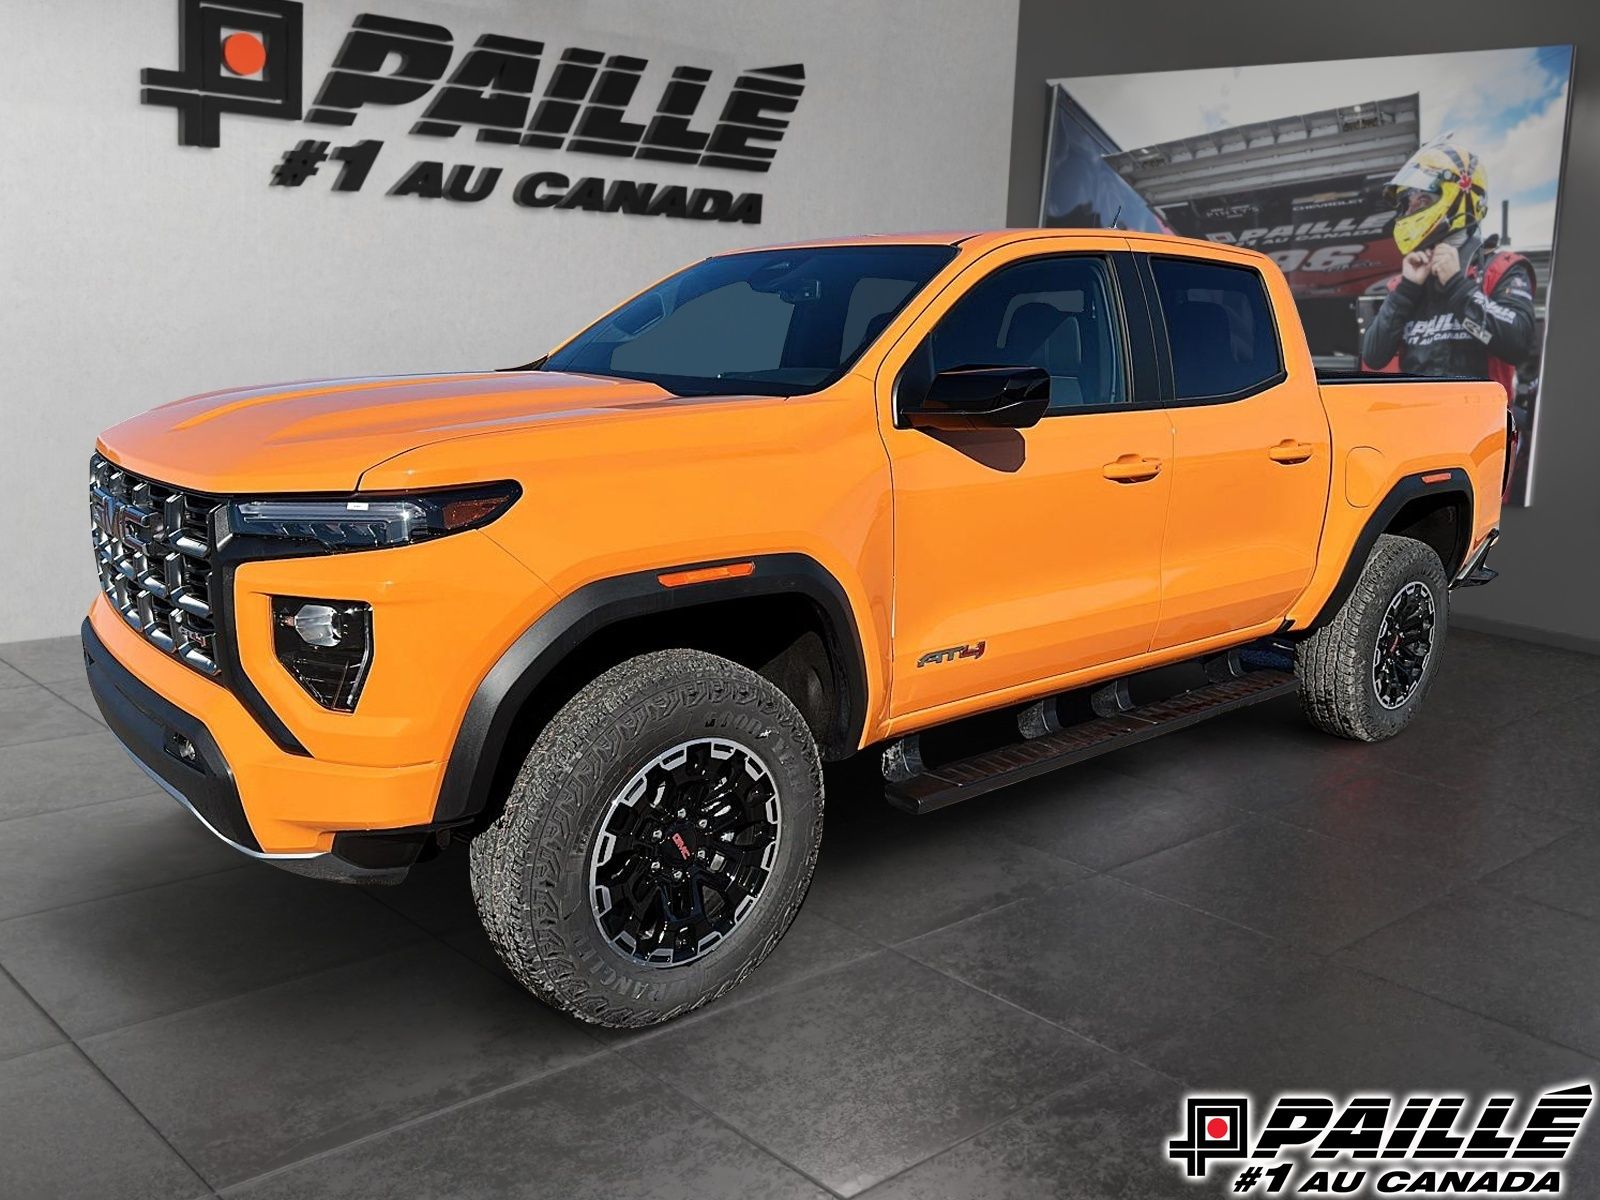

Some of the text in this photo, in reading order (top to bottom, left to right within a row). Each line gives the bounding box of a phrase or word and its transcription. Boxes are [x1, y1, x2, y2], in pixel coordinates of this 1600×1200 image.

[304, 13, 806, 172] PAILLÉ
[269, 139, 763, 224] #1 AU CANADA
[1294, 228, 1383, 241] CANADA
[916, 641, 986, 668] AT4
